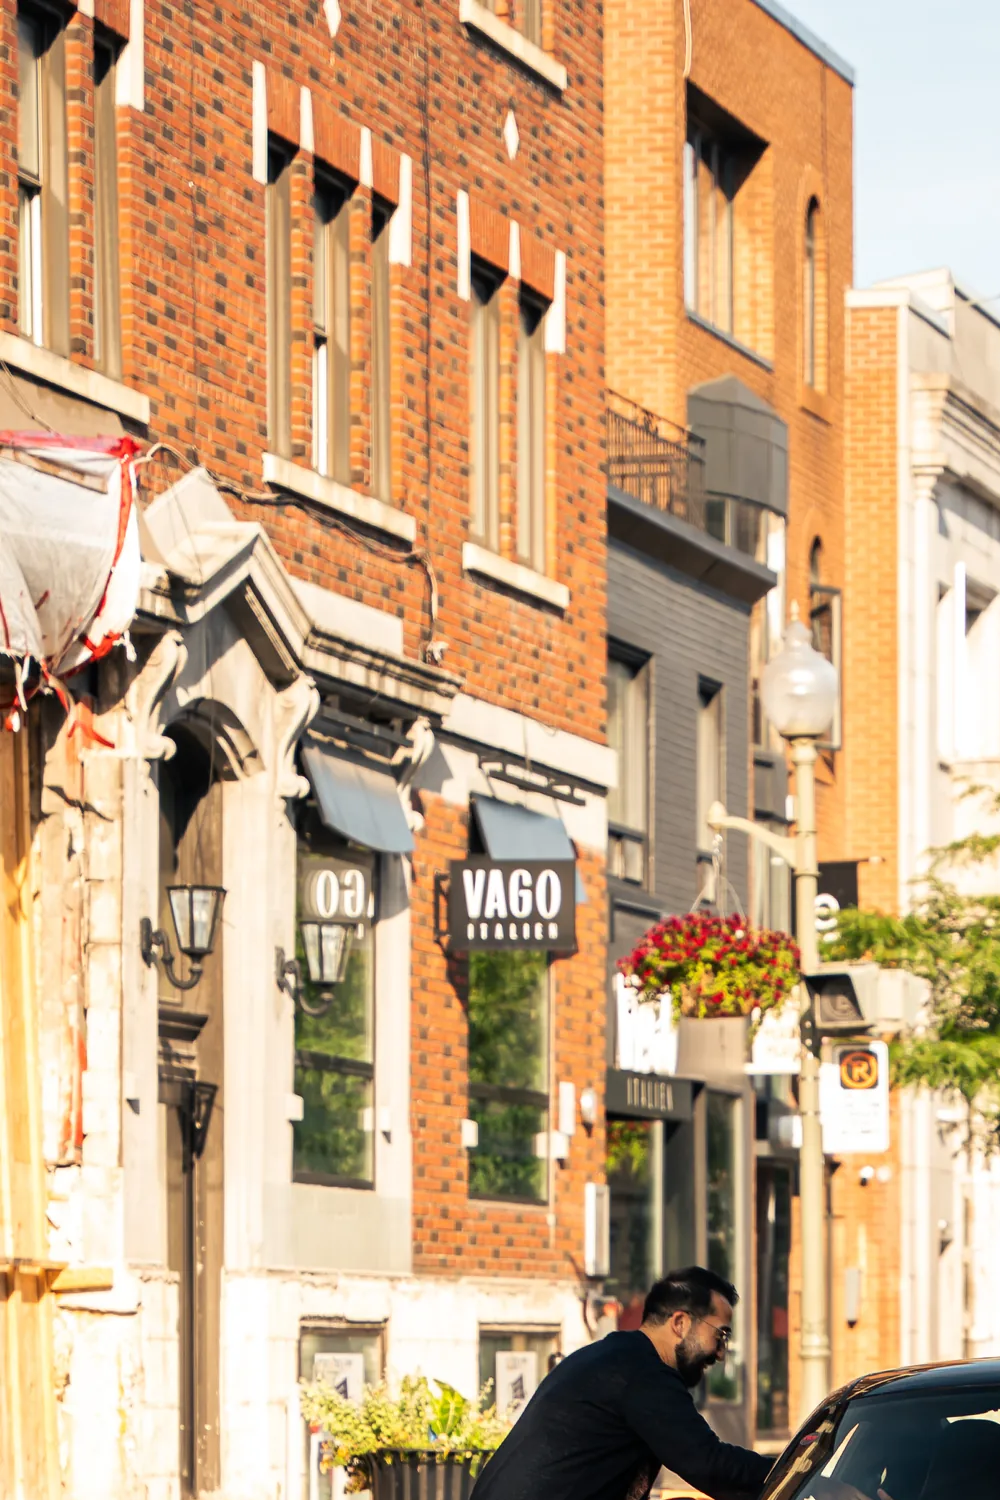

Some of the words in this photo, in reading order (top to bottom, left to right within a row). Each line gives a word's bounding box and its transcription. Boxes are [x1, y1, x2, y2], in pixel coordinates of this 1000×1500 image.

[462, 868, 562, 919] VAGO
[466, 922, 559, 940] ITALIEN
[626, 1077, 674, 1112] ITALIEN
